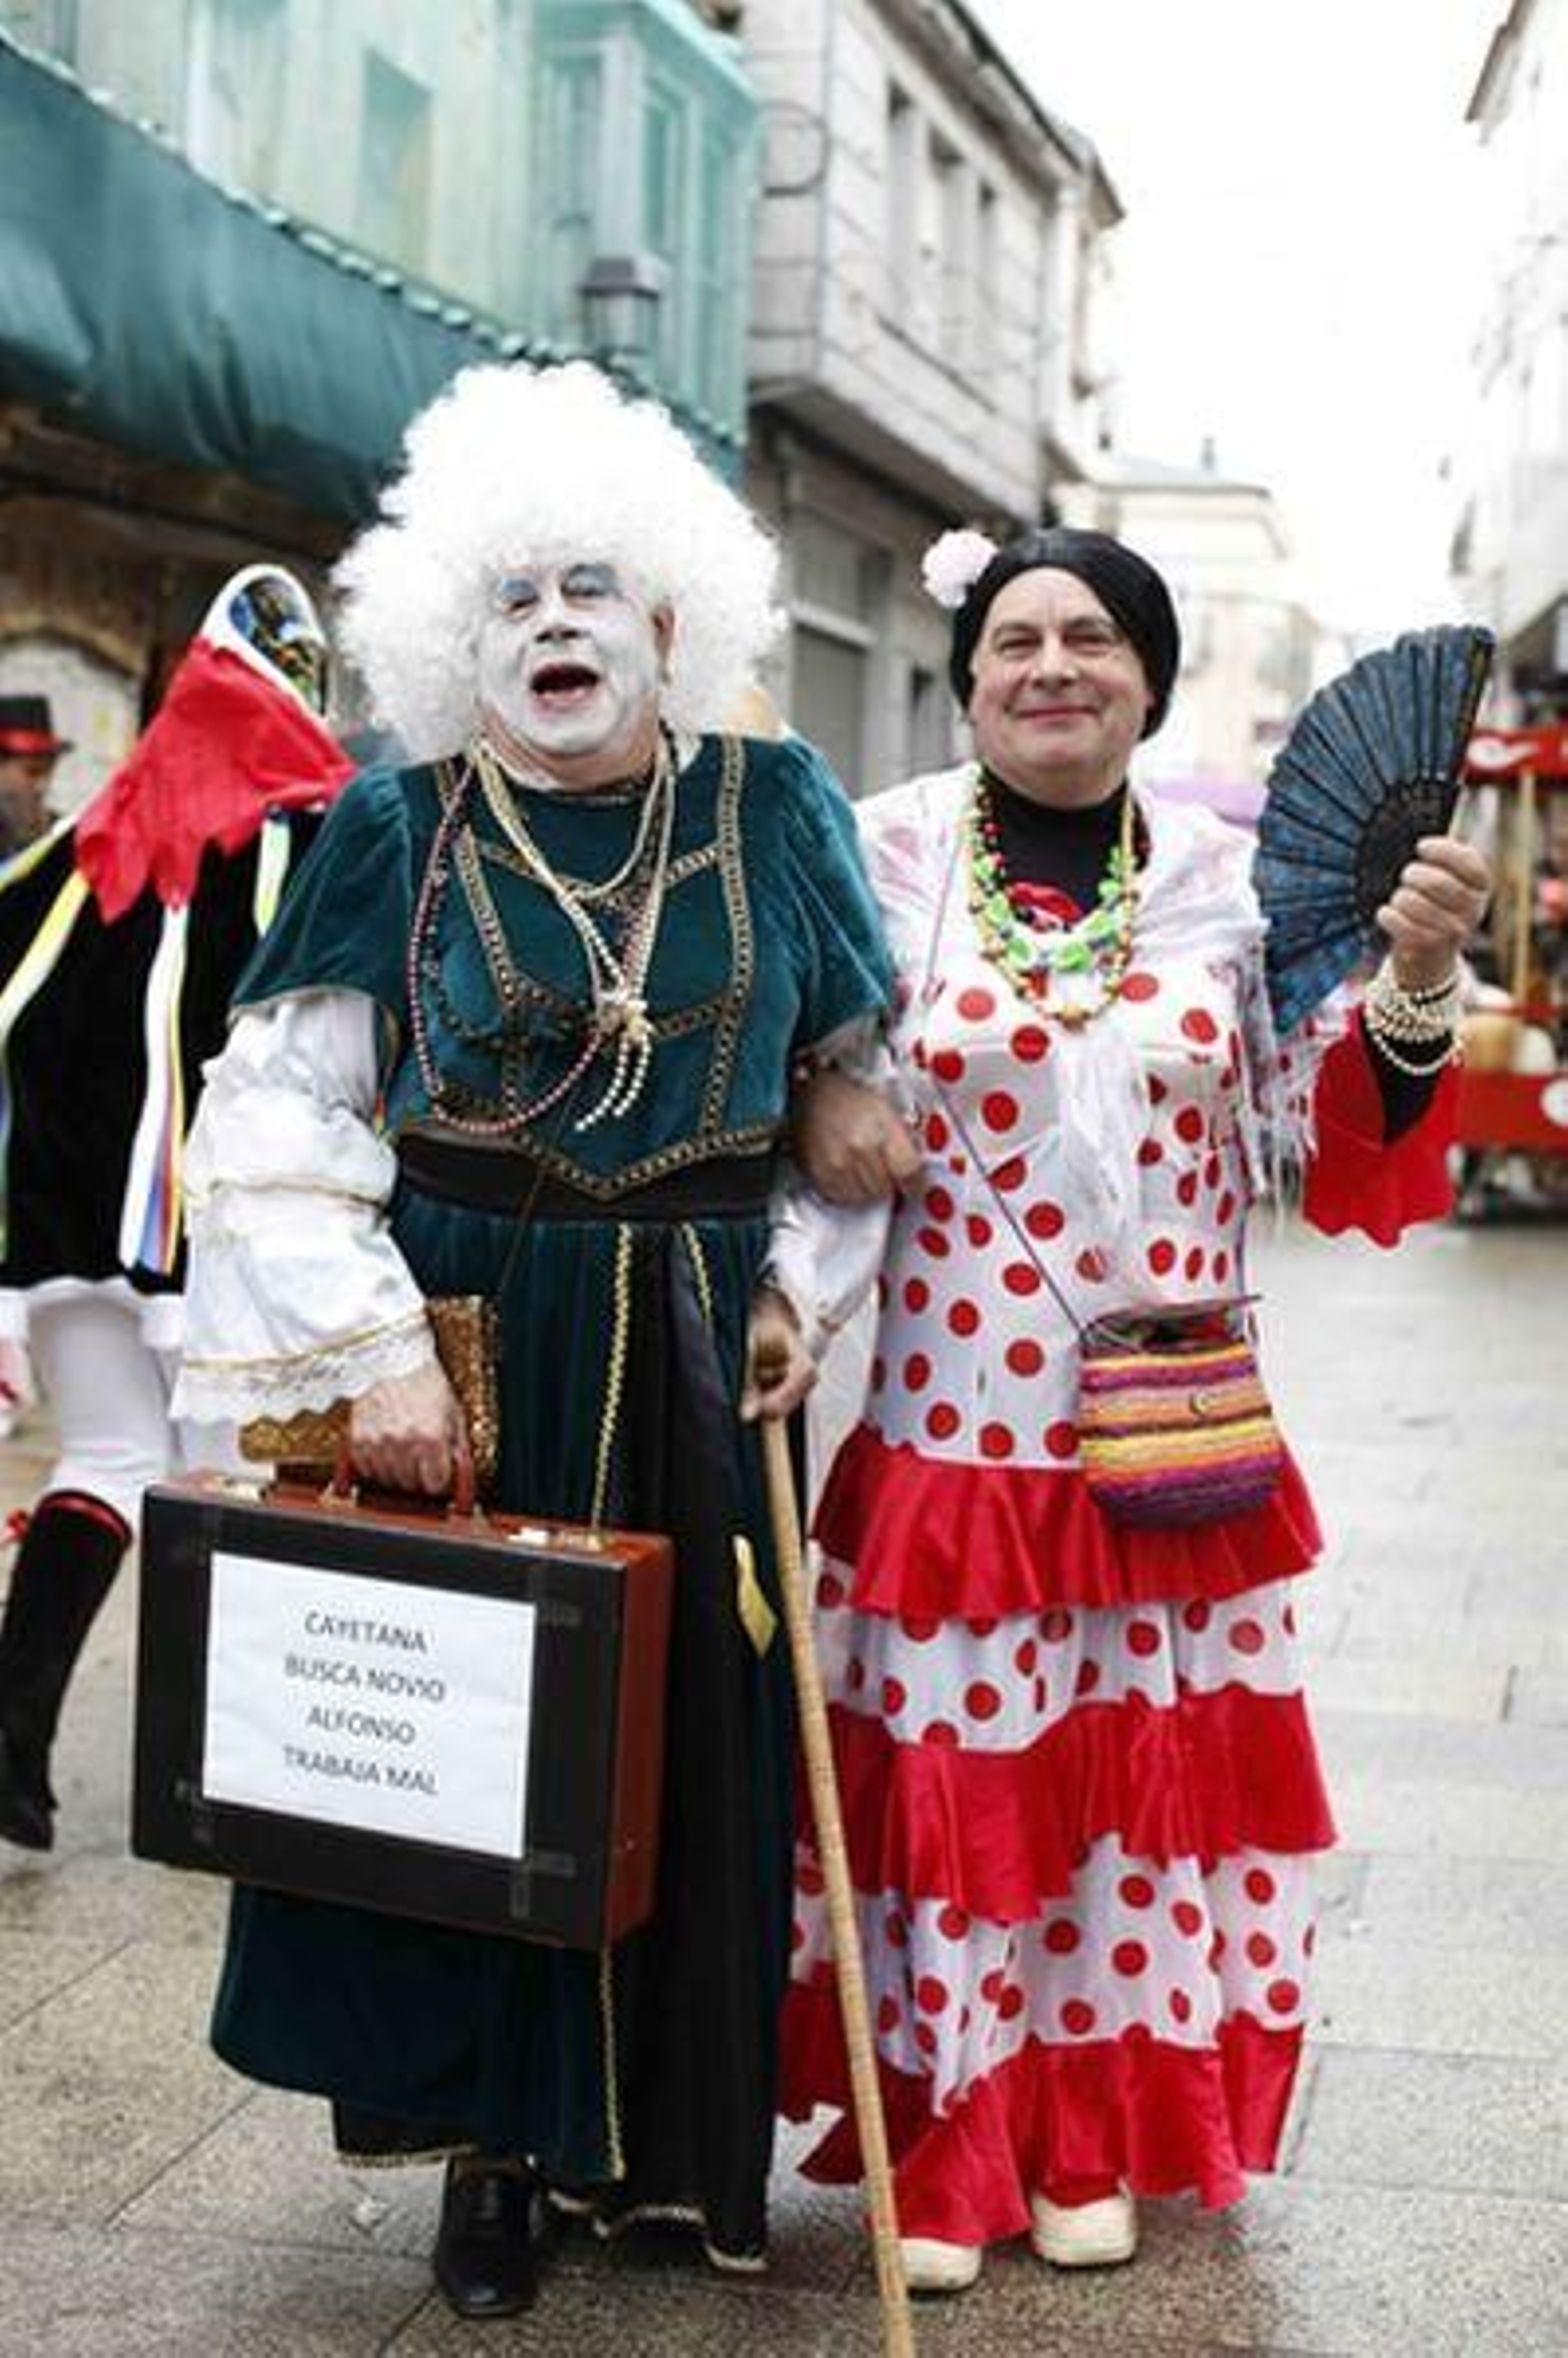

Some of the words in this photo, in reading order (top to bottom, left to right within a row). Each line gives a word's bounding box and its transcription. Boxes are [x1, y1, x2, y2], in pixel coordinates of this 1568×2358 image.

[304, 1611, 427, 1652] CAYETANA
[284, 1654, 362, 1688] BUSCA
[367, 1670, 446, 1702] NOVIO
[306, 1706, 416, 1745] ALFONSO
[282, 1745, 380, 1784] TRABAJA
[386, 1768, 438, 1795] MAL
